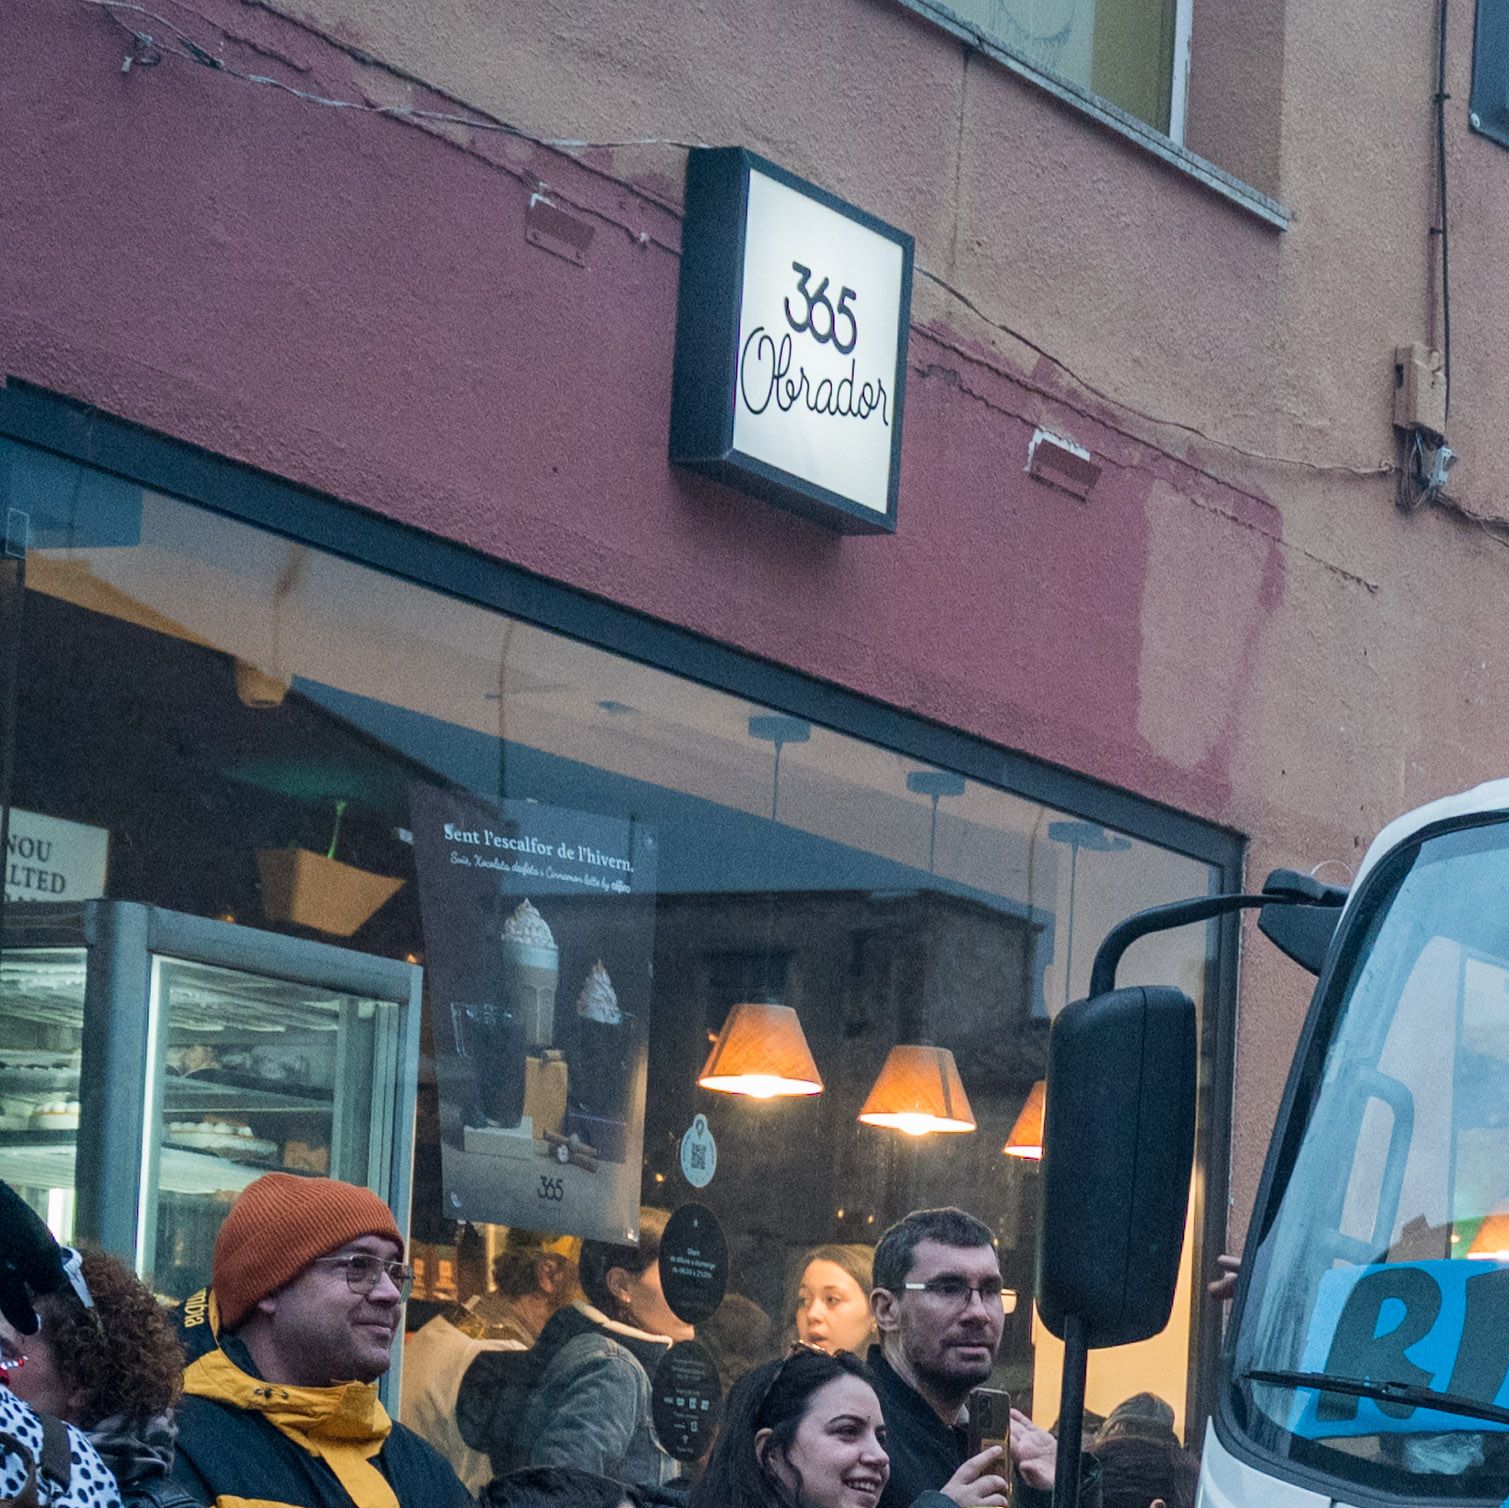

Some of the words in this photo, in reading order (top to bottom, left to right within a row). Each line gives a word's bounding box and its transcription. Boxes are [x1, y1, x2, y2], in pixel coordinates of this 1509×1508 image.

[784, 261, 858, 355] 365
[740, 326, 890, 426] Obrador
[444, 822, 480, 844] Sent
[483, 829, 554, 856] l'escalfor
[557, 842, 575, 860] de
[6, 864, 66, 894] LTED
[537, 1174, 564, 1202] 365
